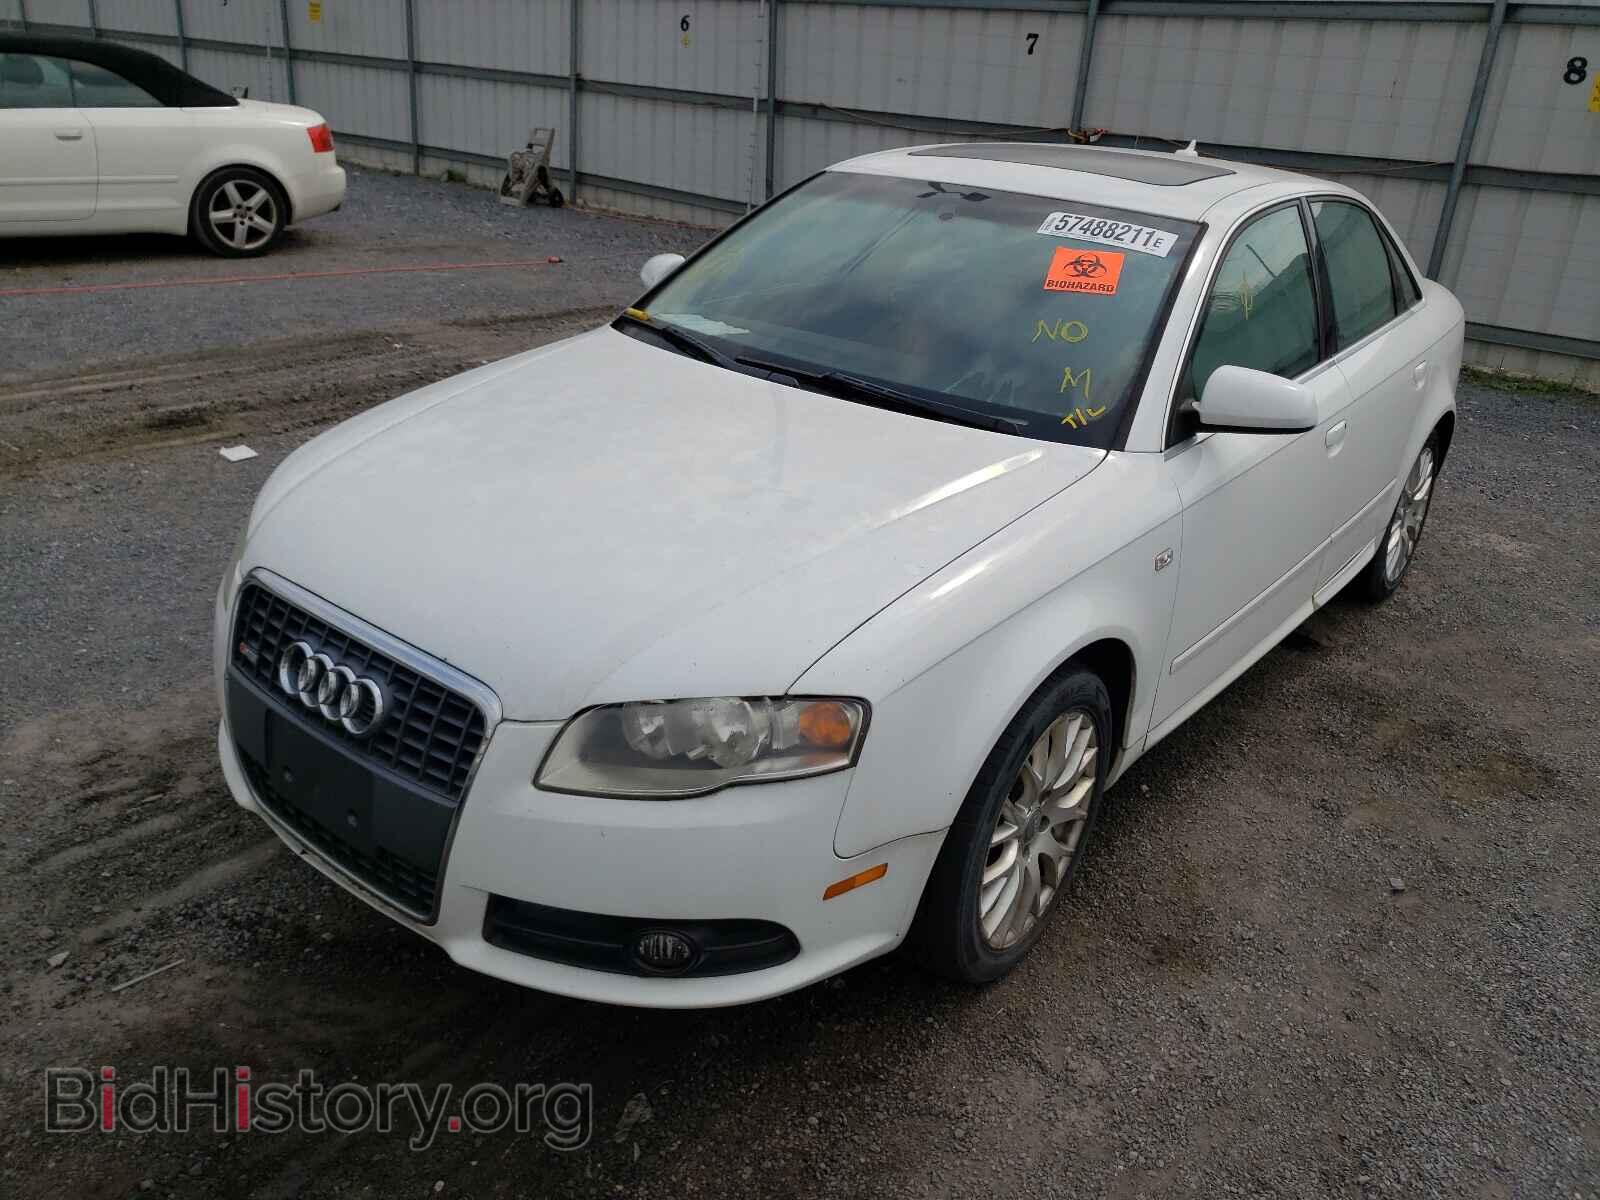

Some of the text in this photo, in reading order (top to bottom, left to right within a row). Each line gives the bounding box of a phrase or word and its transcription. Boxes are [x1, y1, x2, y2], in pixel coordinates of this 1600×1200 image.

[681, 14, 690, 32] 6
[1026, 33, 1039, 55] 7
[1563, 57, 1587, 85] 8
[1054, 214, 1155, 246] 57488211
[1046, 279, 1114, 293] BIOHAZARD
[1032, 318, 1088, 343] NO
[1060, 367, 1091, 399] M
